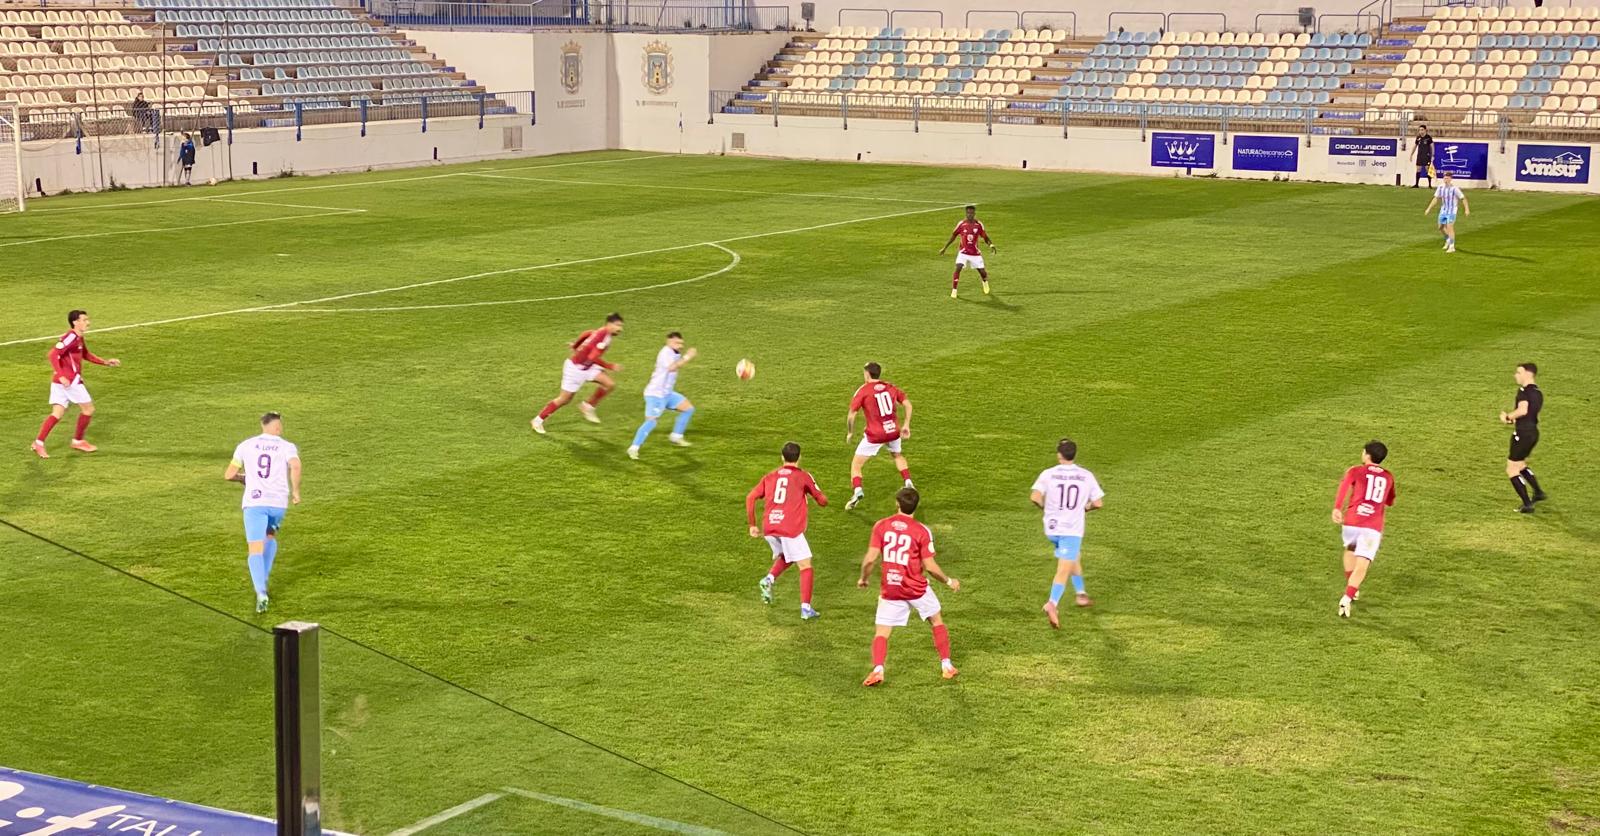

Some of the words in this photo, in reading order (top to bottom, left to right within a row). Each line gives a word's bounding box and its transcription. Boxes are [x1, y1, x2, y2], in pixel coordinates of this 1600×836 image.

[1371, 160, 1387, 168] Jeep
[874, 391, 894, 417] 10
[257, 453, 272, 479] 9
[773, 477, 789, 505] 6
[1056, 483, 1080, 511] 10
[1365, 473, 1387, 504] 18
[883, 531, 912, 566] 22
